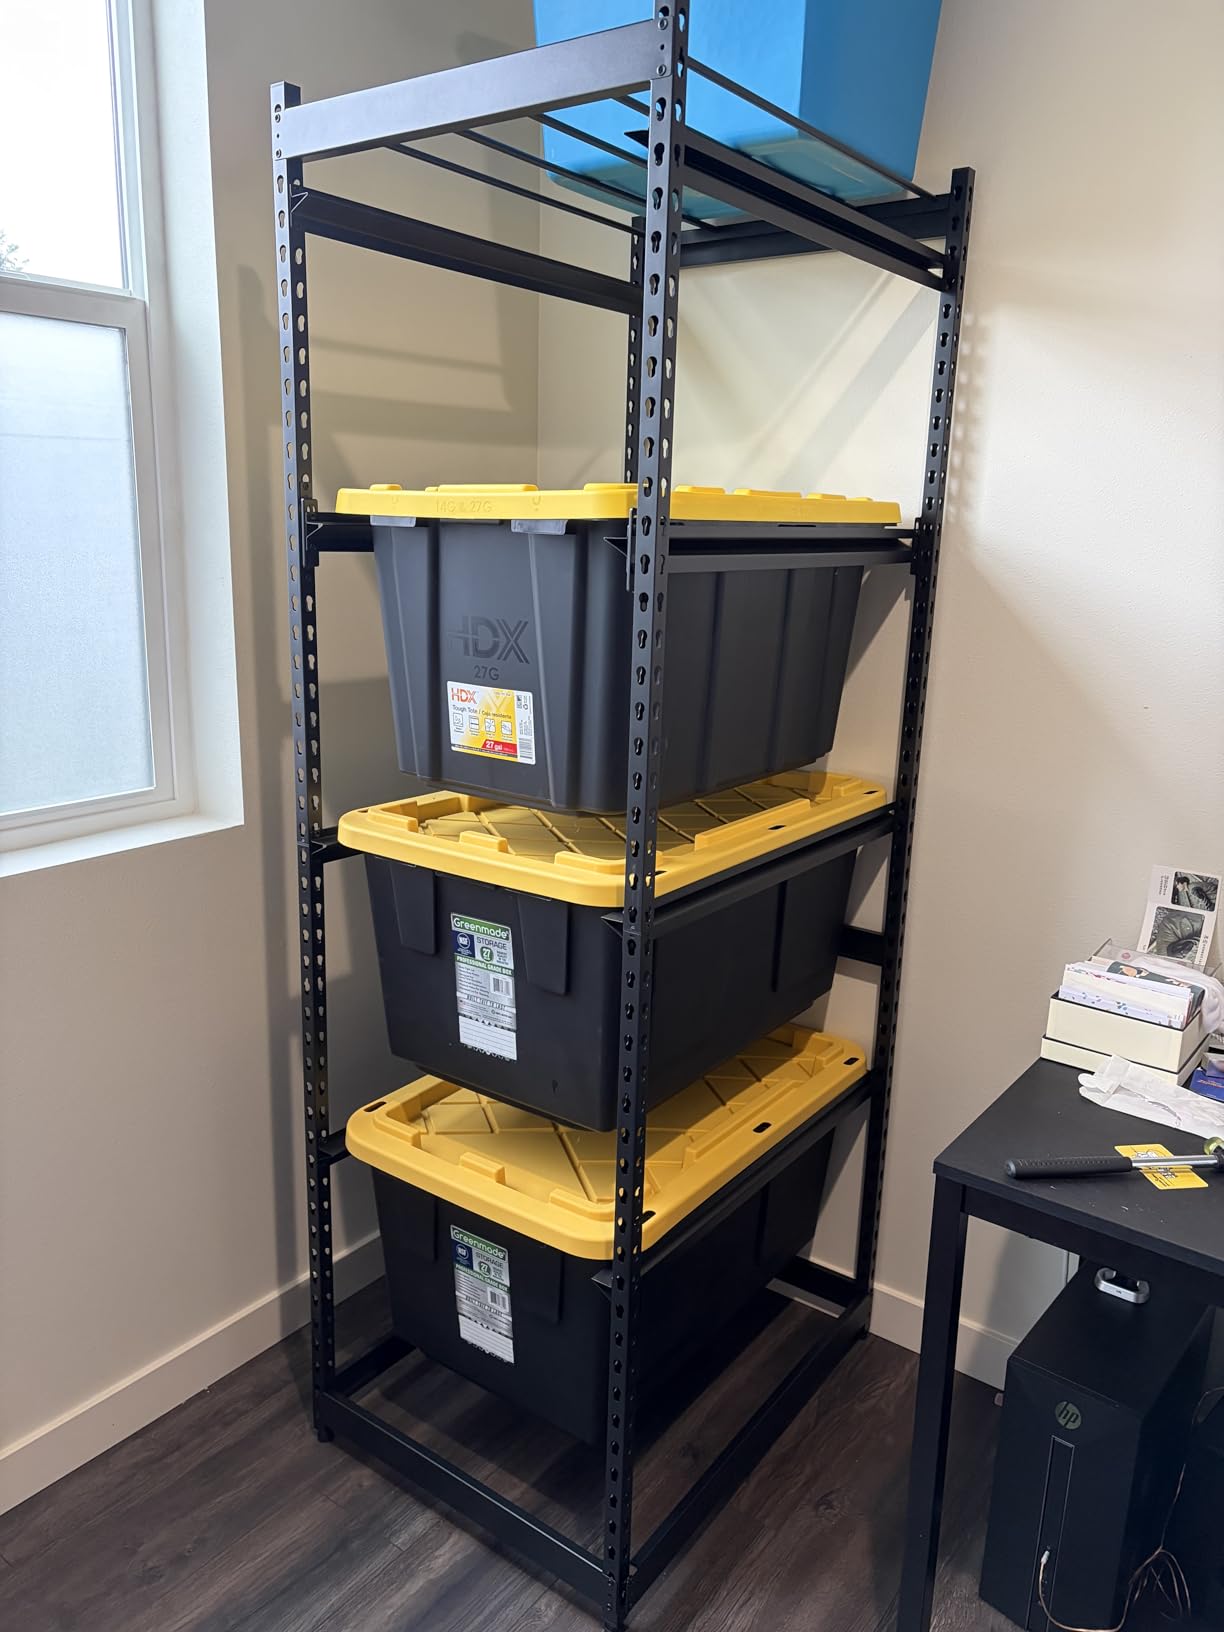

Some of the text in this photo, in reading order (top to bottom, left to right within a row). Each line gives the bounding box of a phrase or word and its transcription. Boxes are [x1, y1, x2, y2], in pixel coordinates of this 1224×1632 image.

[470, 500, 493, 513] 27G
[474, 665, 500, 681] 27G
[451, 688, 476, 704] HDX
[485, 740, 494, 749] 27
[453, 917, 508, 939] Greenmade
[476, 936, 507, 951] STORAGE
[482, 947, 490, 958] 27
[456, 955, 488, 969] PROFESSIONAL
[487, 963, 502, 973] GRADE
[502, 968, 512, 976] BOX
[453, 1229, 505, 1259] Greenmade
[475, 1251, 504, 1269] STORAGE
[480, 1262, 489, 1272] 27
[1057, 1401, 1080, 1428] hp
